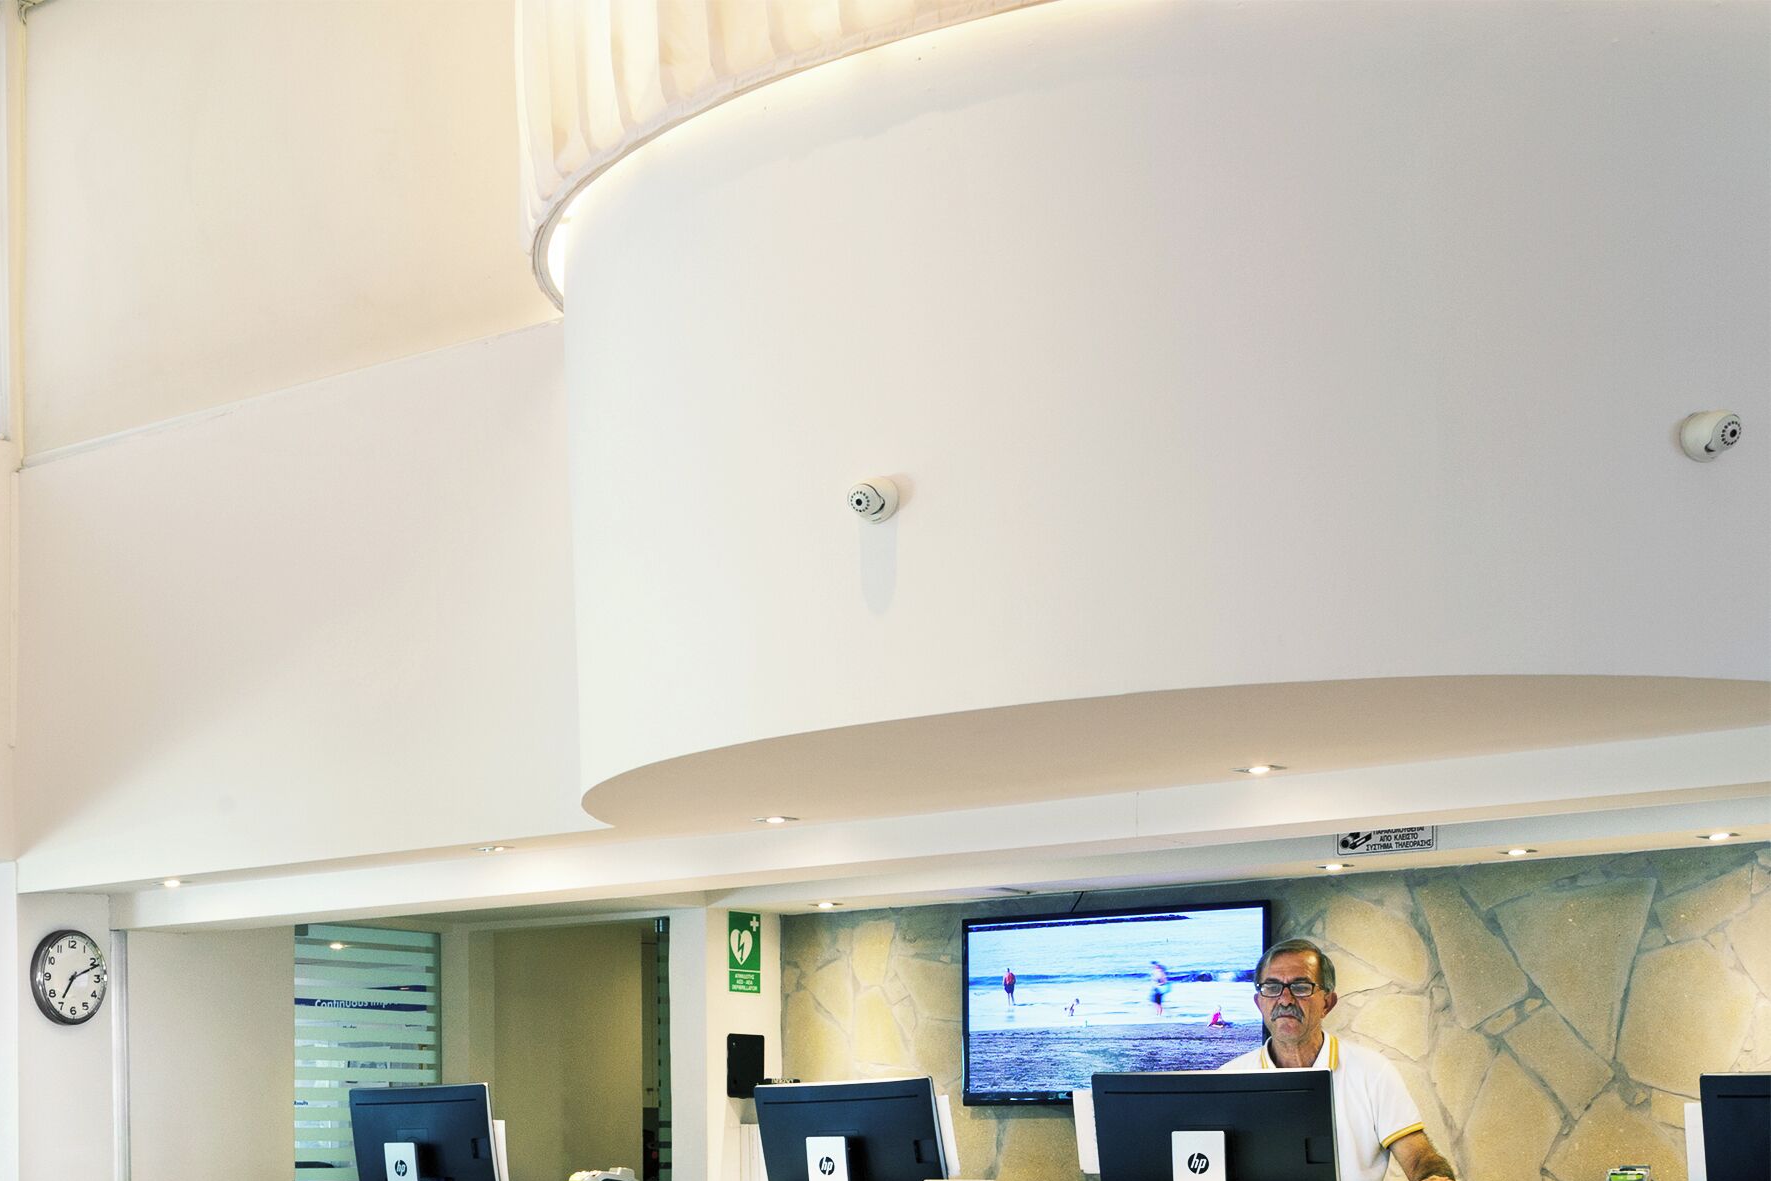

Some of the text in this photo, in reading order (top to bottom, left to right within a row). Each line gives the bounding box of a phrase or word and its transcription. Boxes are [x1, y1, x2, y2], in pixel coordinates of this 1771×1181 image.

[57, 945, 62, 953] 11
[68, 940, 77, 949] 12
[48, 956, 55, 965] 10
[90, 958, 97, 966] 2
[44, 972, 51, 981] 9
[93, 975, 100, 983] 3
[49, 989, 56, 998] 8
[91, 990, 97, 998] 4
[58, 1002, 64, 1010] 7
[70, 1006, 77, 1015] 6
[82, 1002, 89, 1011] 5
[395, 1160, 407, 1176] hp
[820, 1157, 834, 1175] hp
[1189, 1153, 1208, 1174] hp
